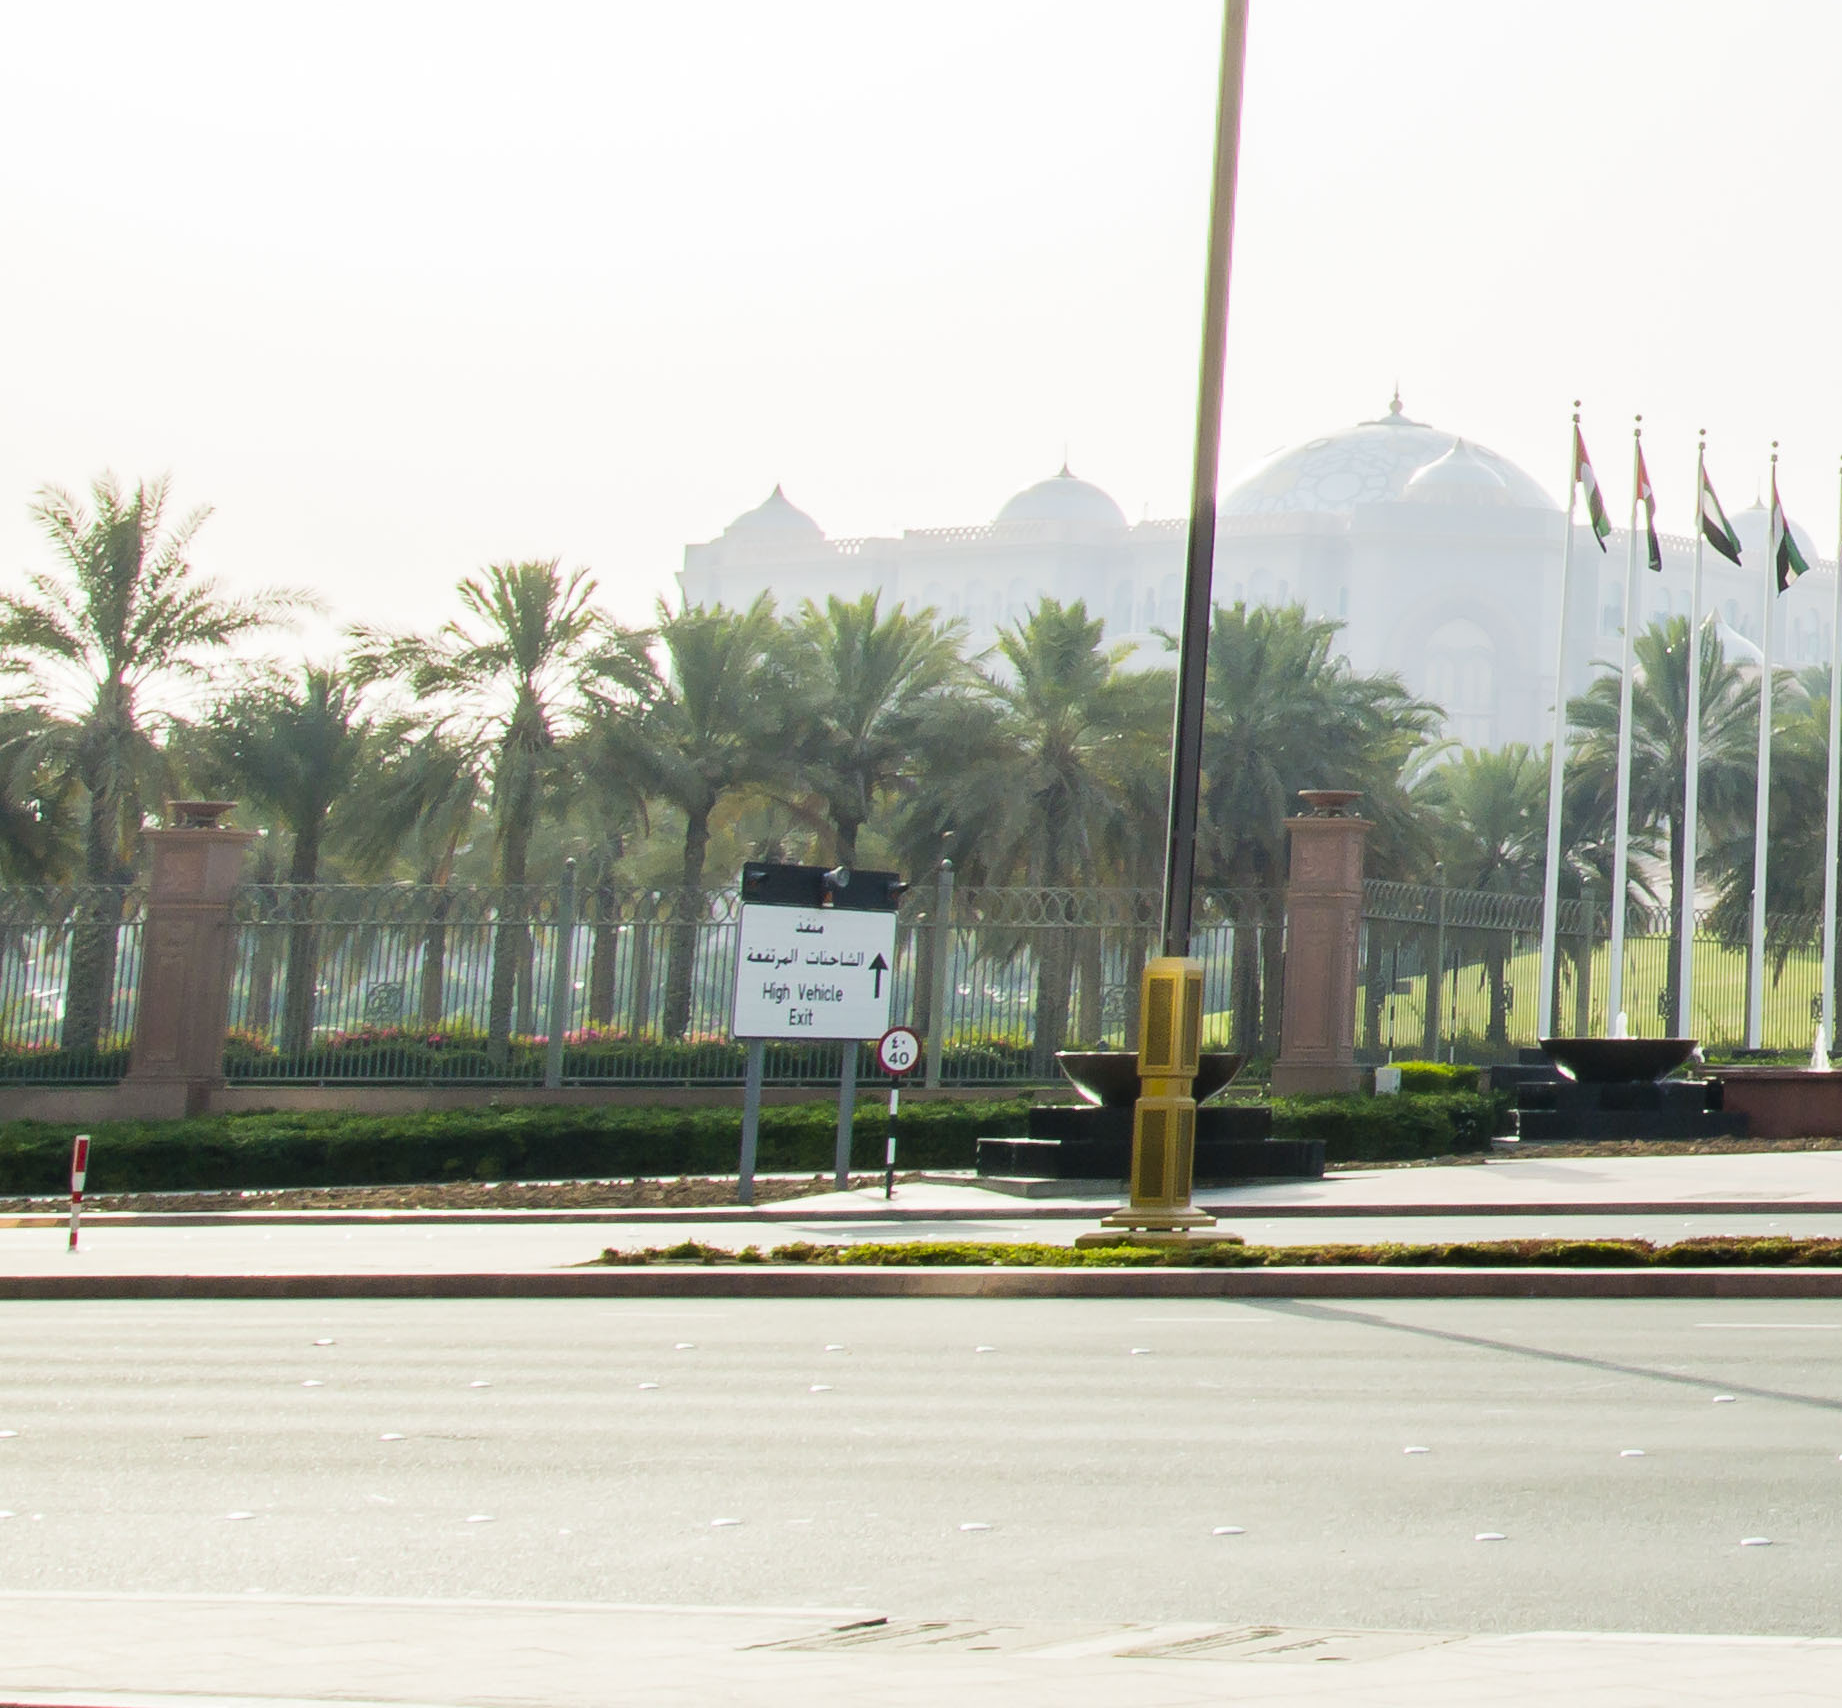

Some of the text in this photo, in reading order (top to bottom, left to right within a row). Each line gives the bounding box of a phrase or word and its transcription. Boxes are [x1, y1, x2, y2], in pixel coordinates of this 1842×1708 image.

[747, 946, 864, 970] الشاحنات المرتفعة
[762, 981, 844, 1005] High Vehicle
[788, 1007, 814, 1027] Exit
[891, 1035, 906, 1050] ٤٠
[888, 1052, 910, 1066] 40
